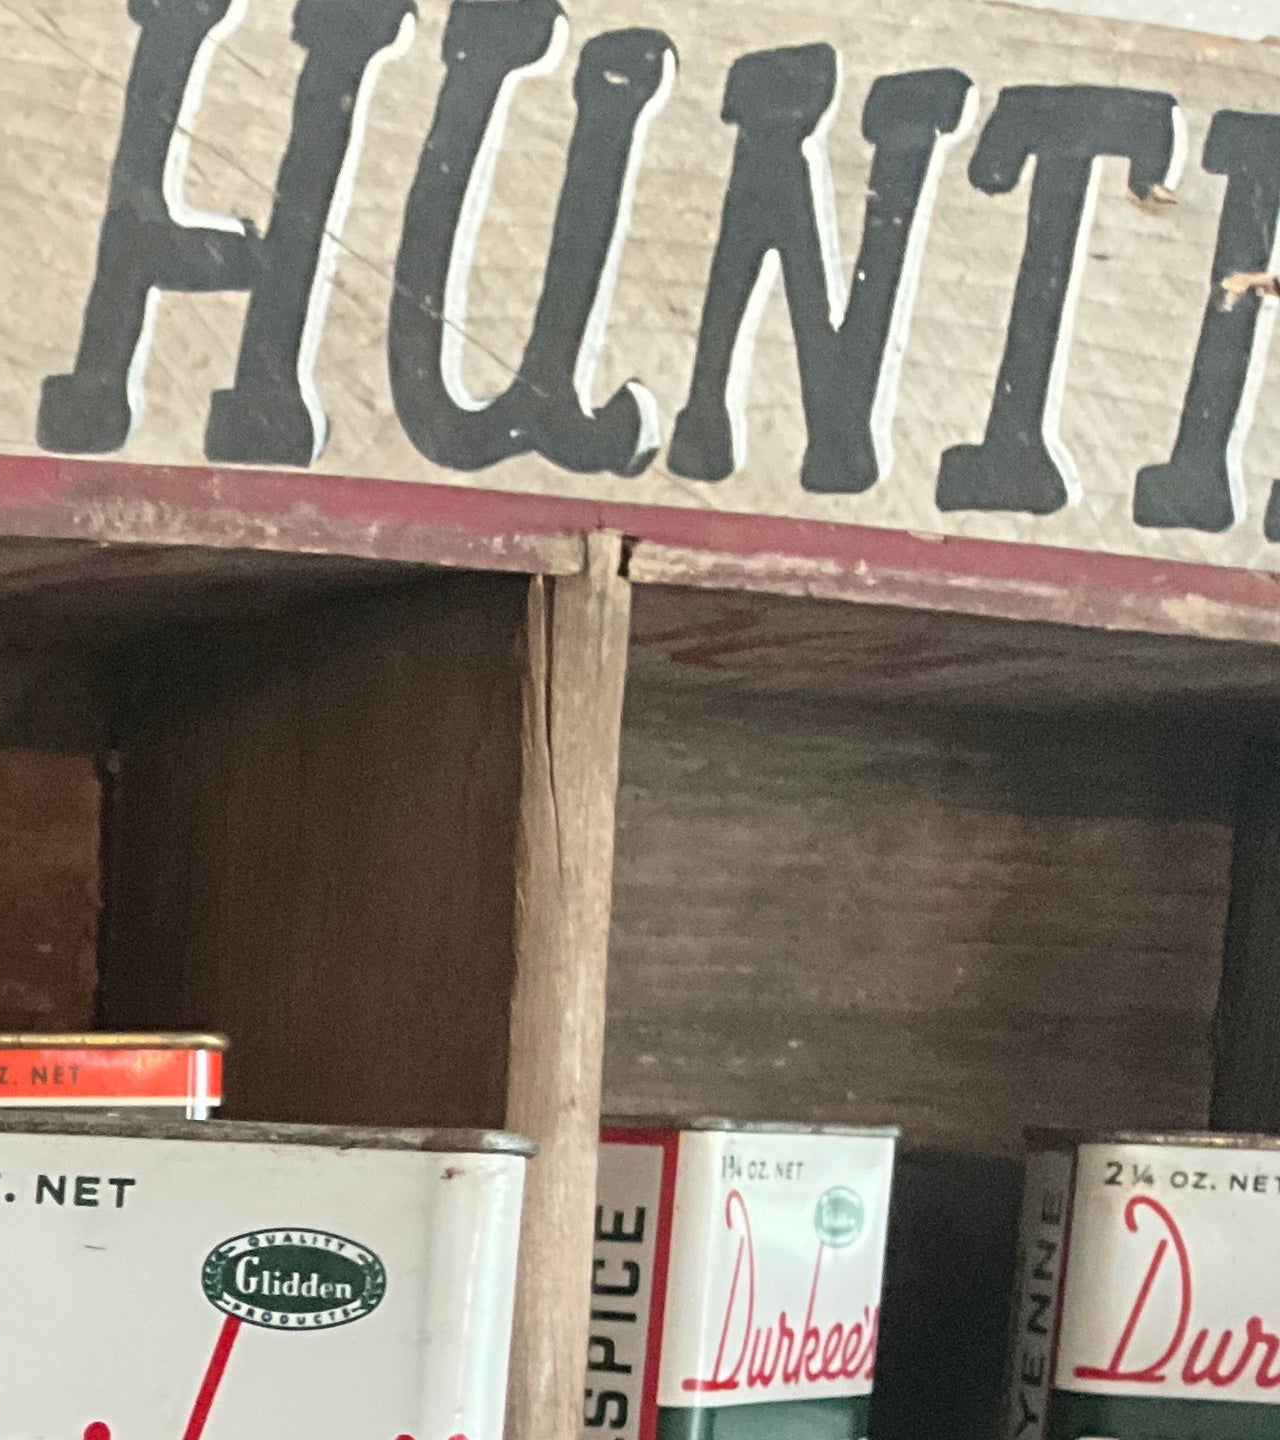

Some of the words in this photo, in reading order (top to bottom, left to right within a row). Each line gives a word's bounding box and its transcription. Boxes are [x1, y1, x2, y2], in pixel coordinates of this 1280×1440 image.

[37, 0, 1280, 542] HUNTI
[31, 1064, 81, 1086] NET
[774, 1161, 804, 1180] NET
[1169, 1170, 1216, 1191] OZ.
[36, 1175, 137, 1208] NET
[247, 1232, 346, 1250] QUALITY
[235, 1256, 353, 1299] Glidden
[231, 1302, 352, 1326] PRODUCTS
